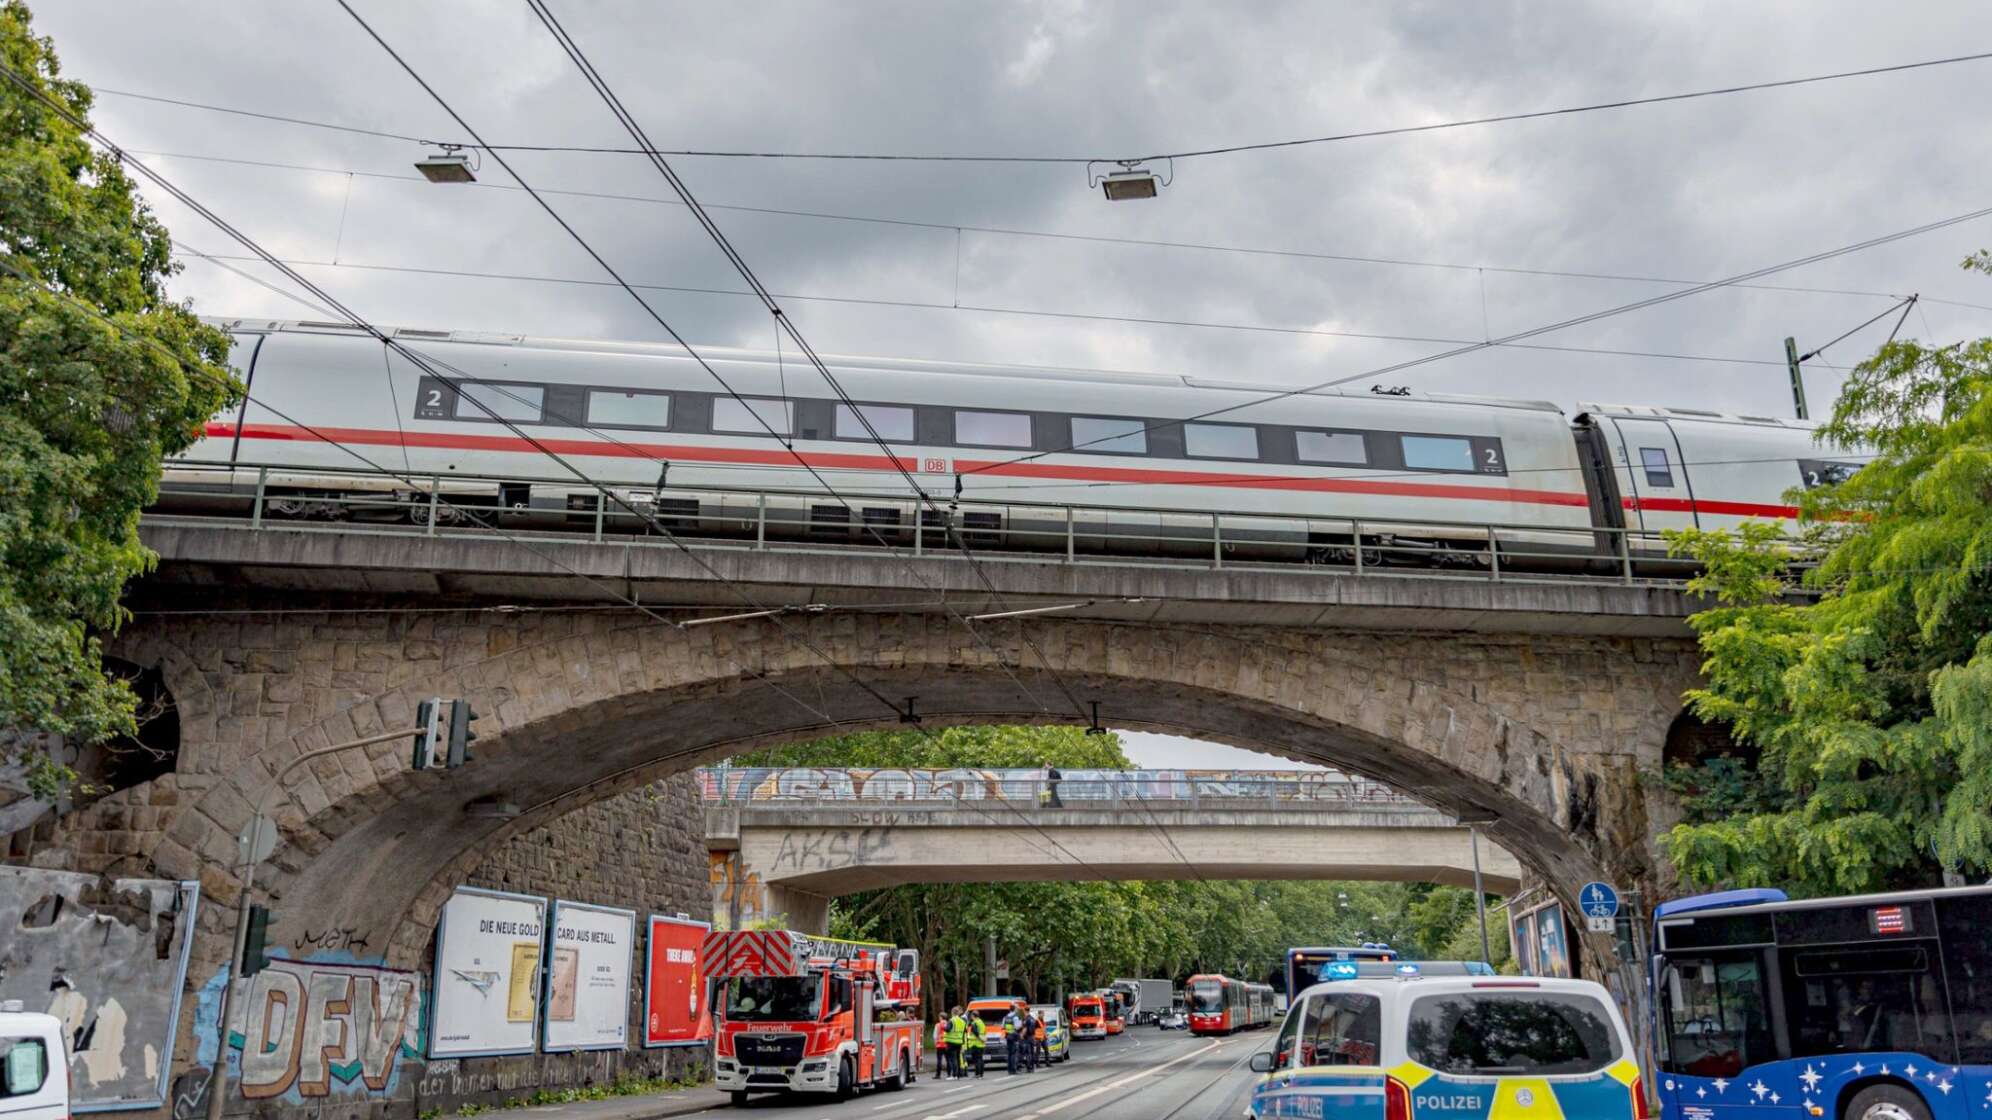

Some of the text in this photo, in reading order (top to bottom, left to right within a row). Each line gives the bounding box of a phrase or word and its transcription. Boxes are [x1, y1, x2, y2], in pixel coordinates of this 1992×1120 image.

[427, 390, 441, 406] 2
[1485, 449, 1498, 464] 2
[926, 459, 945, 472] DB
[1808, 471, 1820, 486] 2
[480, 919, 540, 937] DIE NEUE GOLD
[557, 927, 617, 945] CARD AUS METALL.
[747, 1022, 793, 1034] Feuerwehr
[1416, 1095, 1481, 1110] POLIZEI
